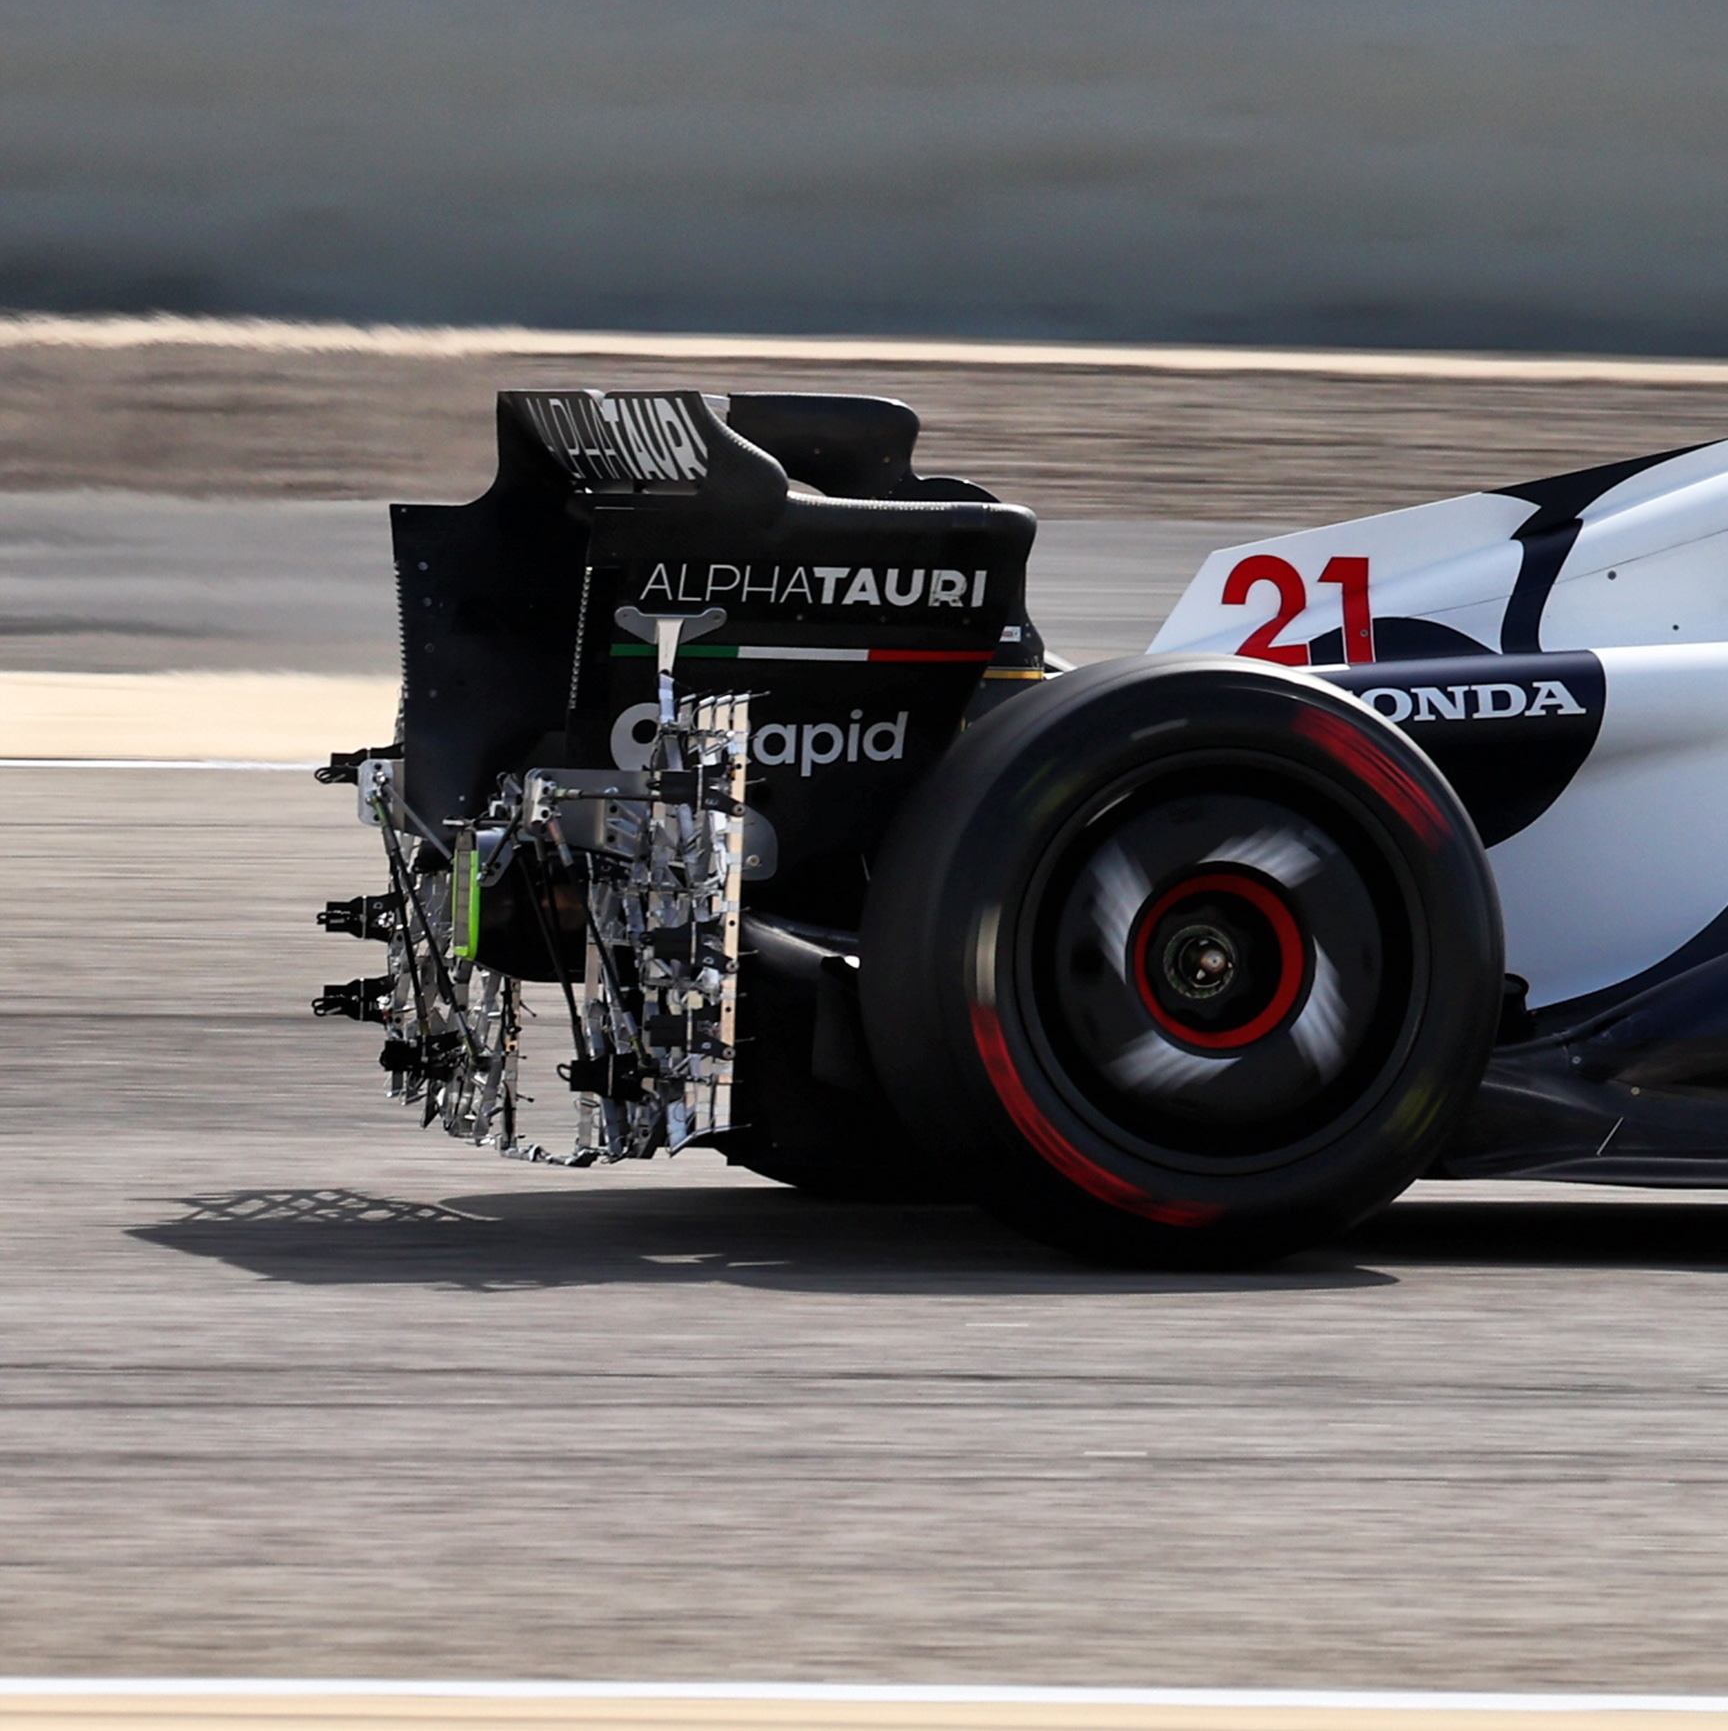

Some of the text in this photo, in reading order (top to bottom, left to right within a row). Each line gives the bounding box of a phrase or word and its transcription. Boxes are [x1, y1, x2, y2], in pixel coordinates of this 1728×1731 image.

[639, 562, 988, 608] ALPHATAURI
[1221, 554, 1375, 666] 21
[1346, 680, 1587, 723] ONDA
[745, 708, 908, 778] apid
